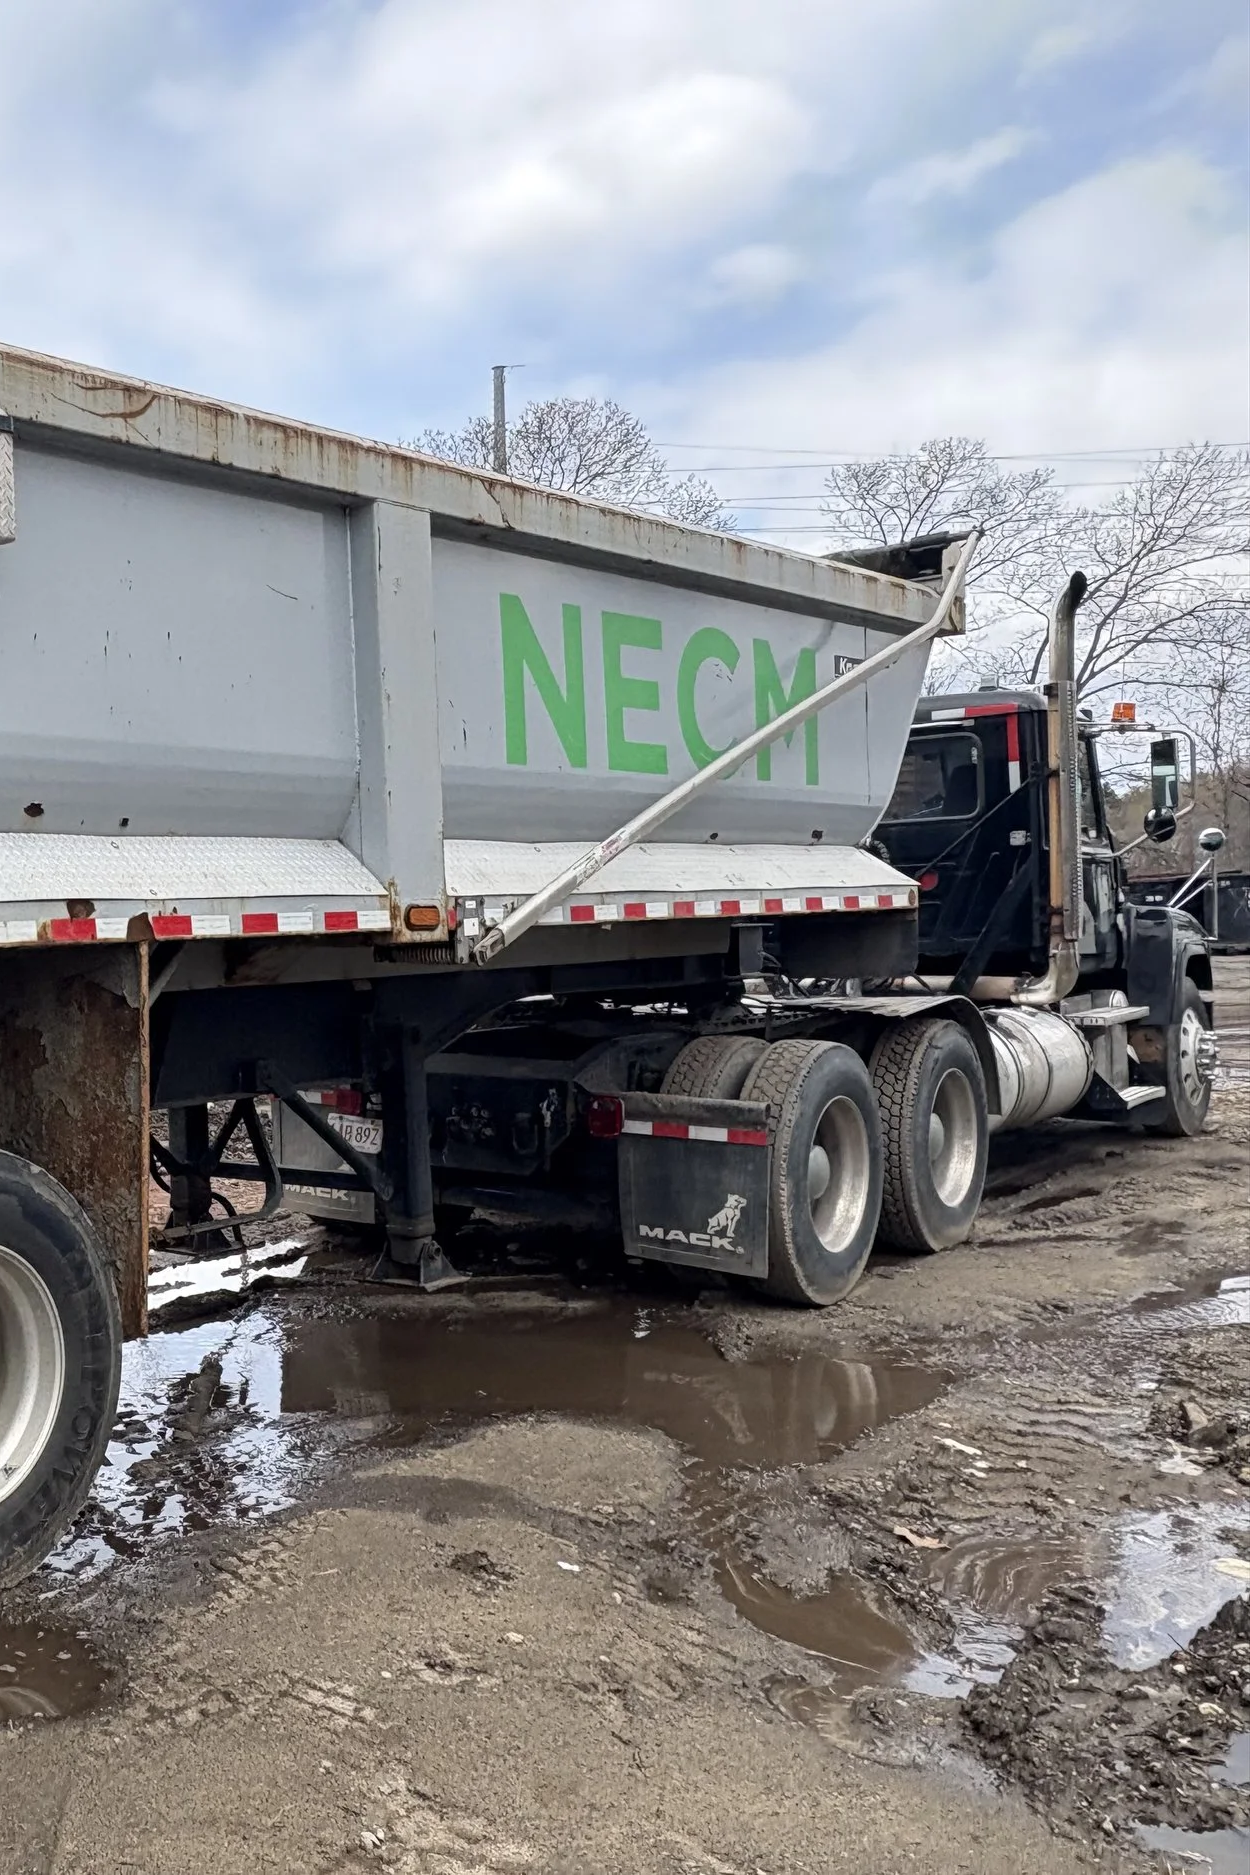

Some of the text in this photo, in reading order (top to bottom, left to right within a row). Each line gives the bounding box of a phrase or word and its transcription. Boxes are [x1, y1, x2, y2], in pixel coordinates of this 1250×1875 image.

[499, 592, 819, 786] NECM
[283, 1183, 349, 1201] MACK
[638, 1224, 736, 1252] MACK
